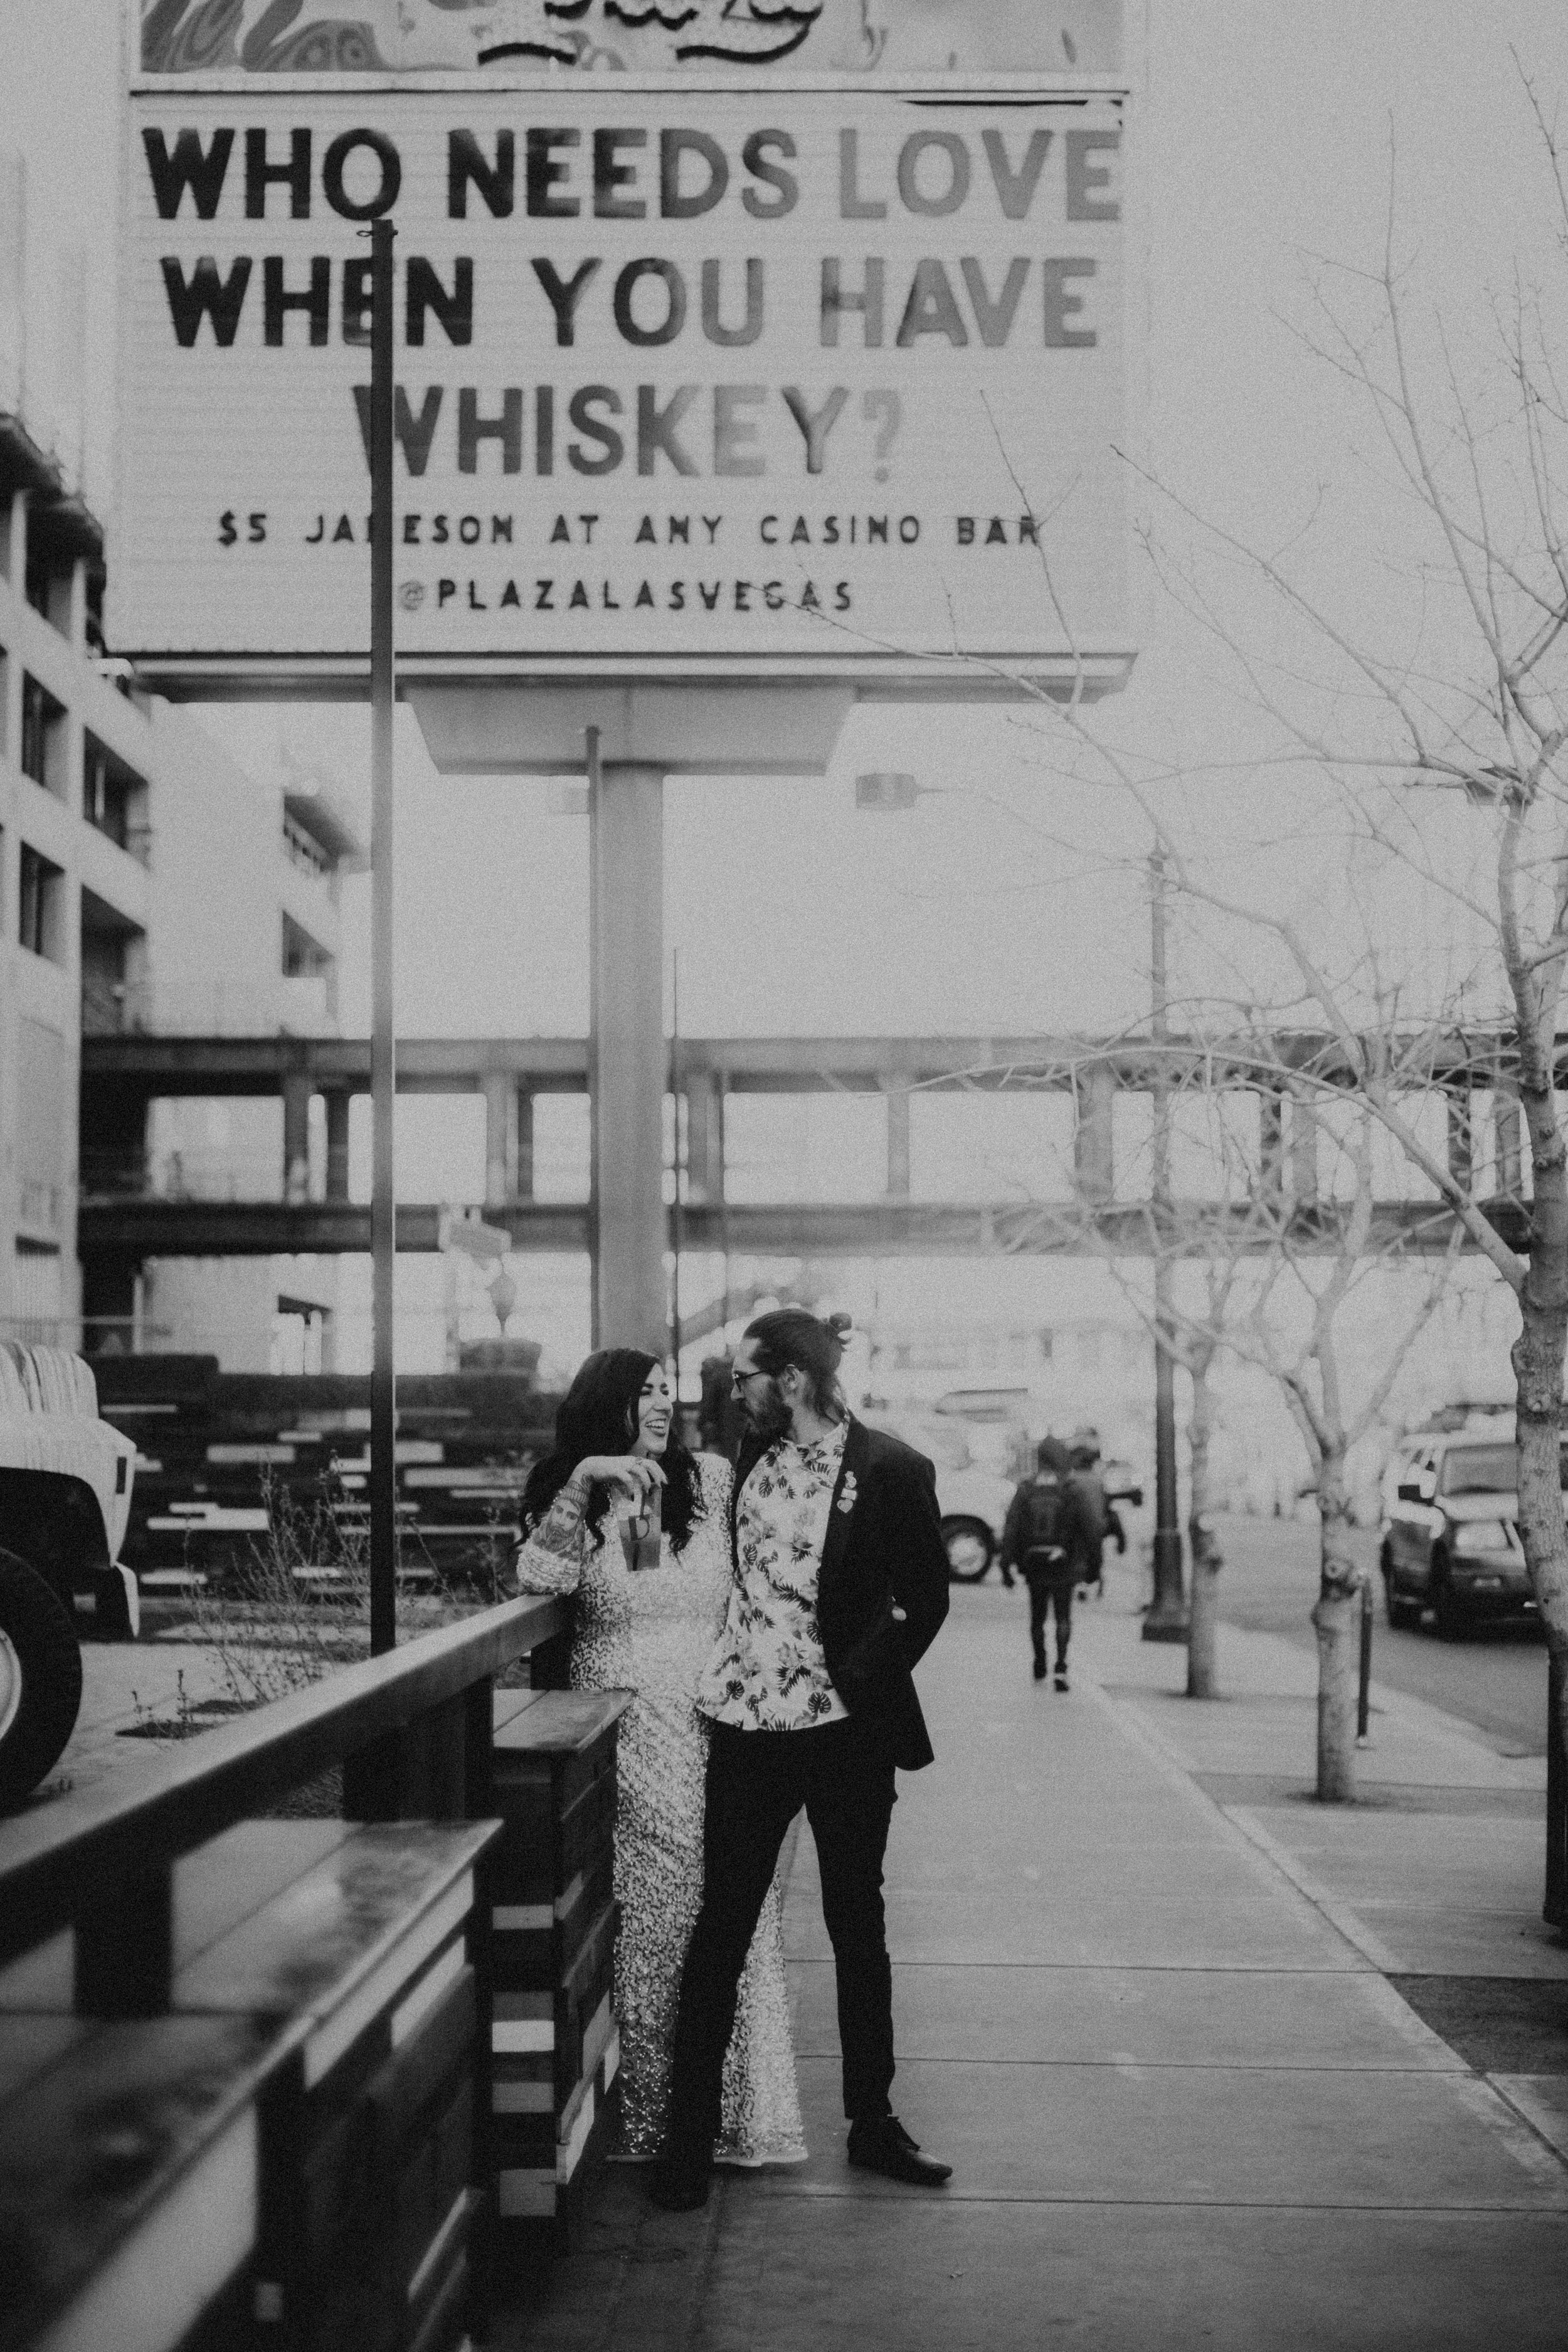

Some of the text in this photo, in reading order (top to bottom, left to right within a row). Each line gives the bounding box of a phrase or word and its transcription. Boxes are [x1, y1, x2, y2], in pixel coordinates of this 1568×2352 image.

[140, 127, 1120, 221] WHO NEEDS LOVE
[530, 257, 763, 347] YOU
[820, 256, 1098, 349] HAVE
[351, 384, 903, 484] WHISKEY?
[217, 510, 1039, 546] $5 JAESON AT ANY CASINO BAR
[399, 578, 851, 611] @PLAZALASVEGAS
